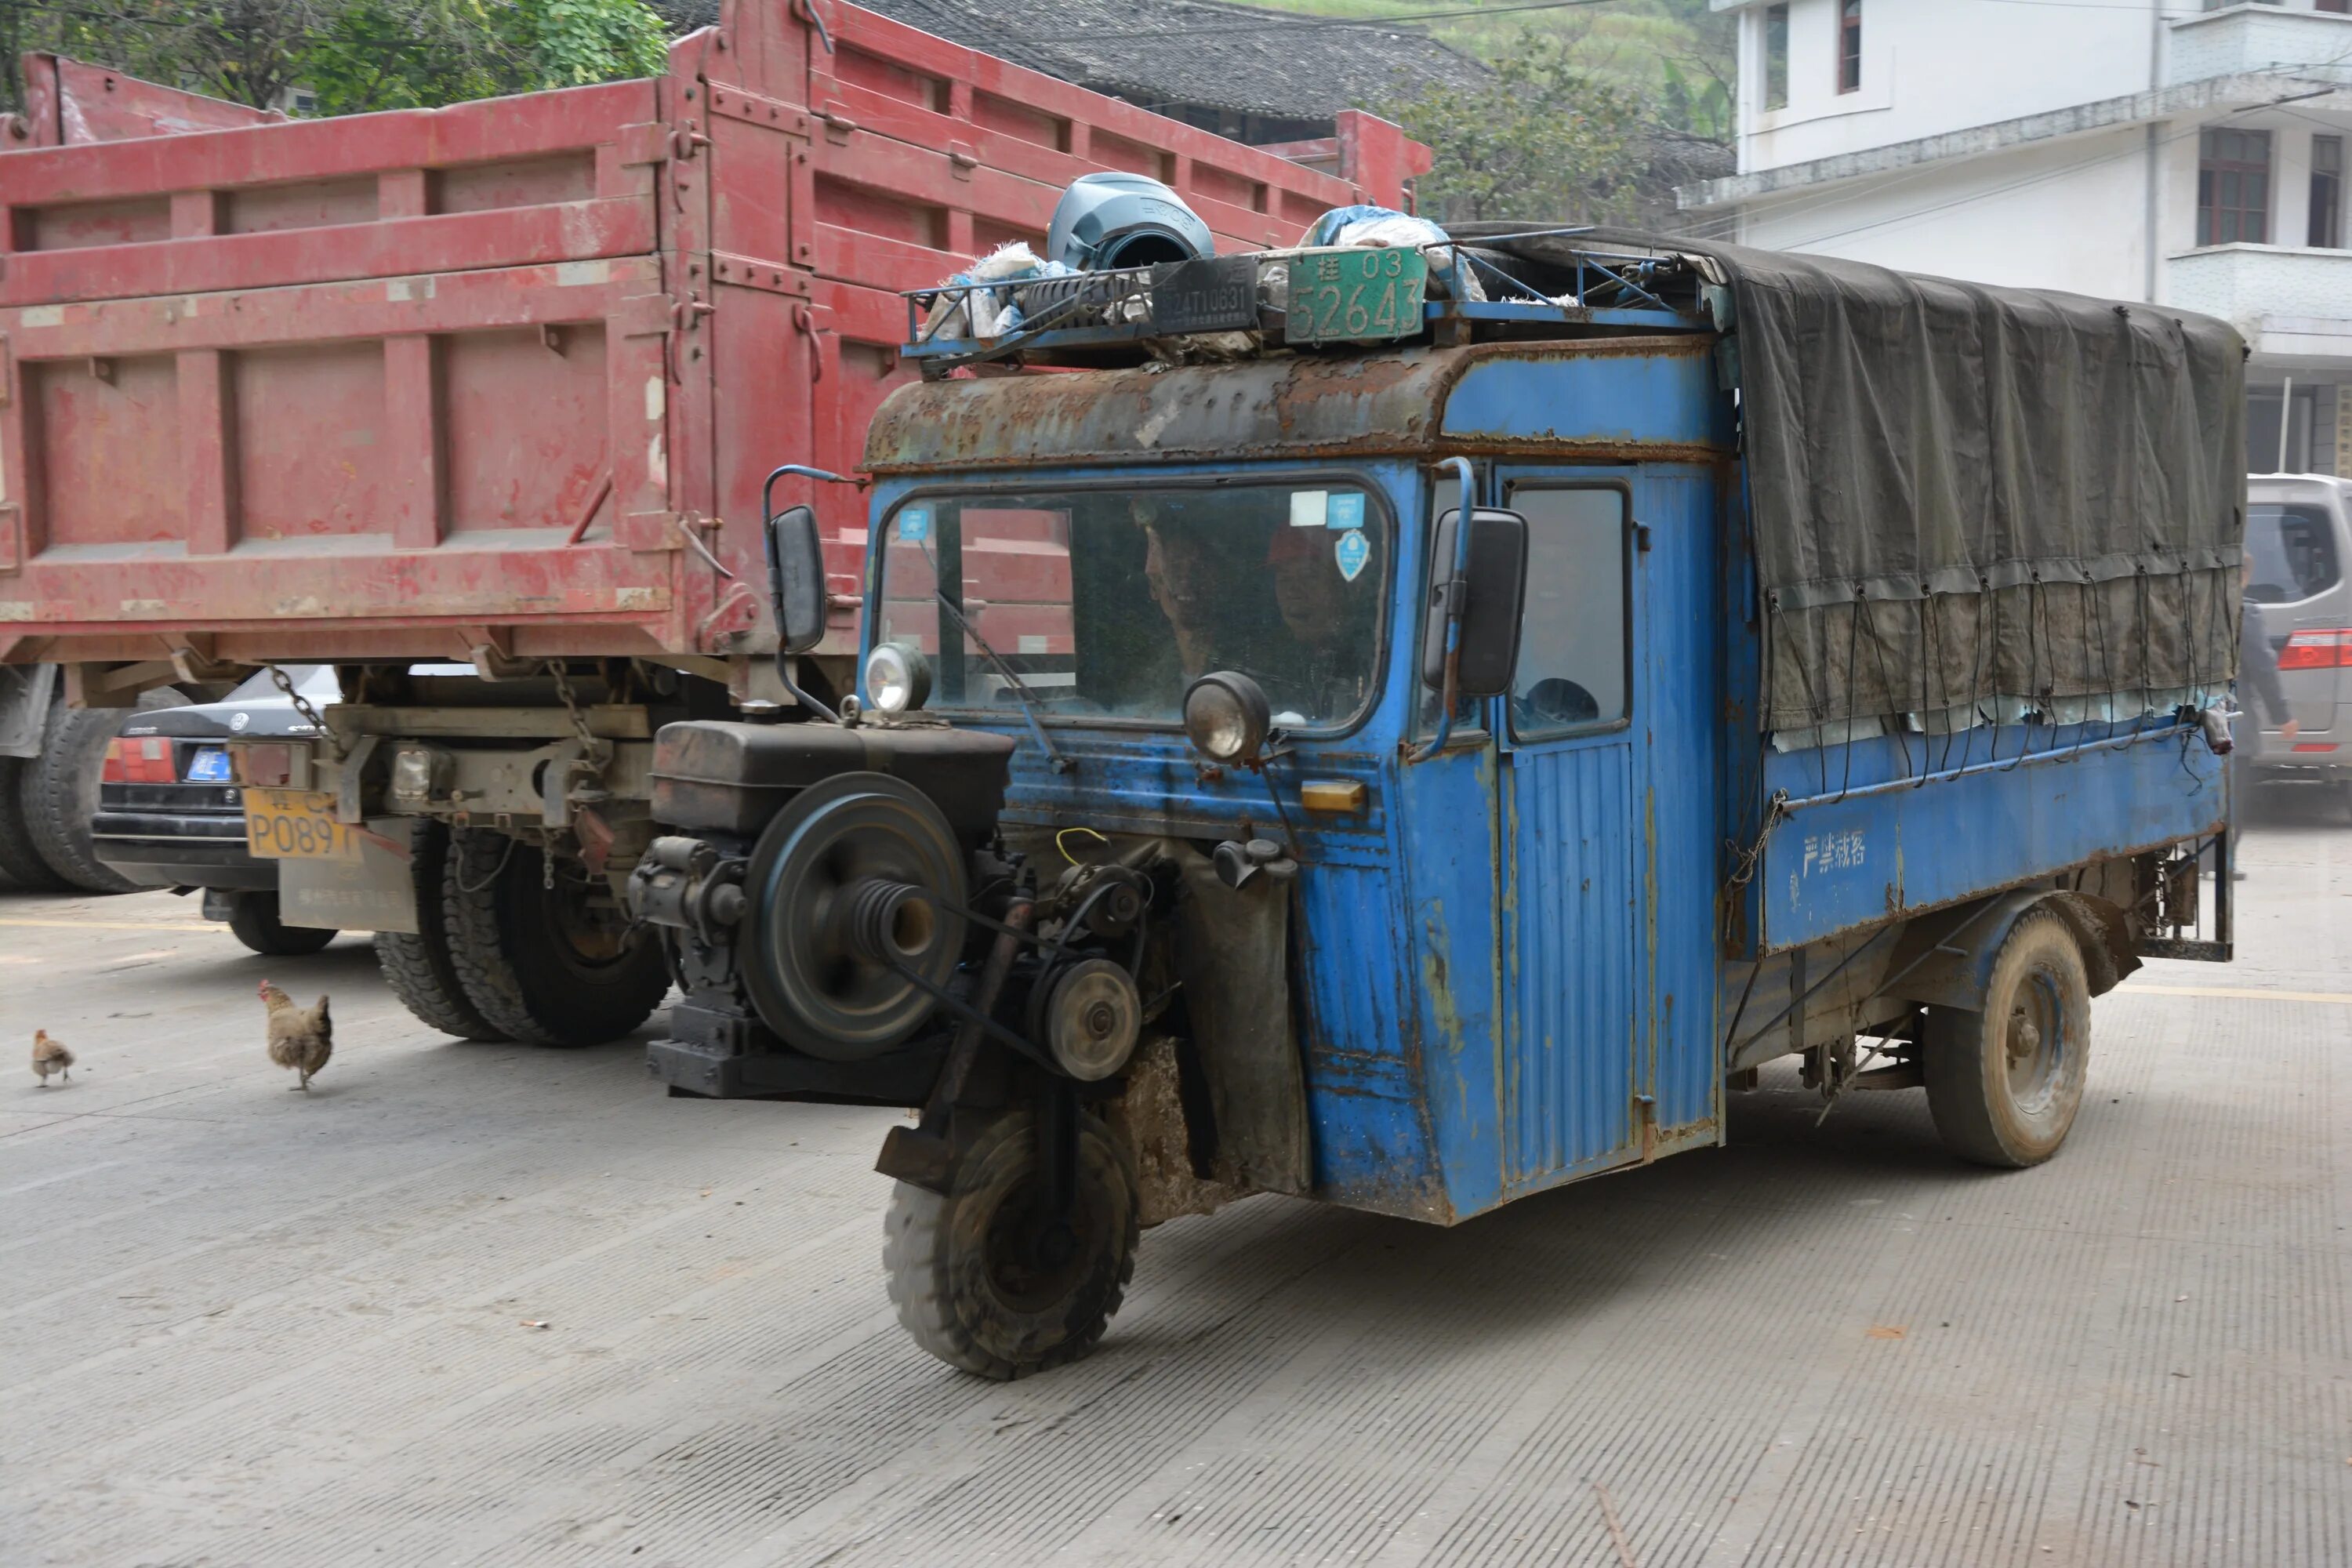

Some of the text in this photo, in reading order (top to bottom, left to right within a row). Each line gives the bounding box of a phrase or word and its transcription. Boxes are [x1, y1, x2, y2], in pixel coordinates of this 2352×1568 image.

[1317, 251, 1402, 281] 桂 03
[1291, 278, 1420, 339] 52643
